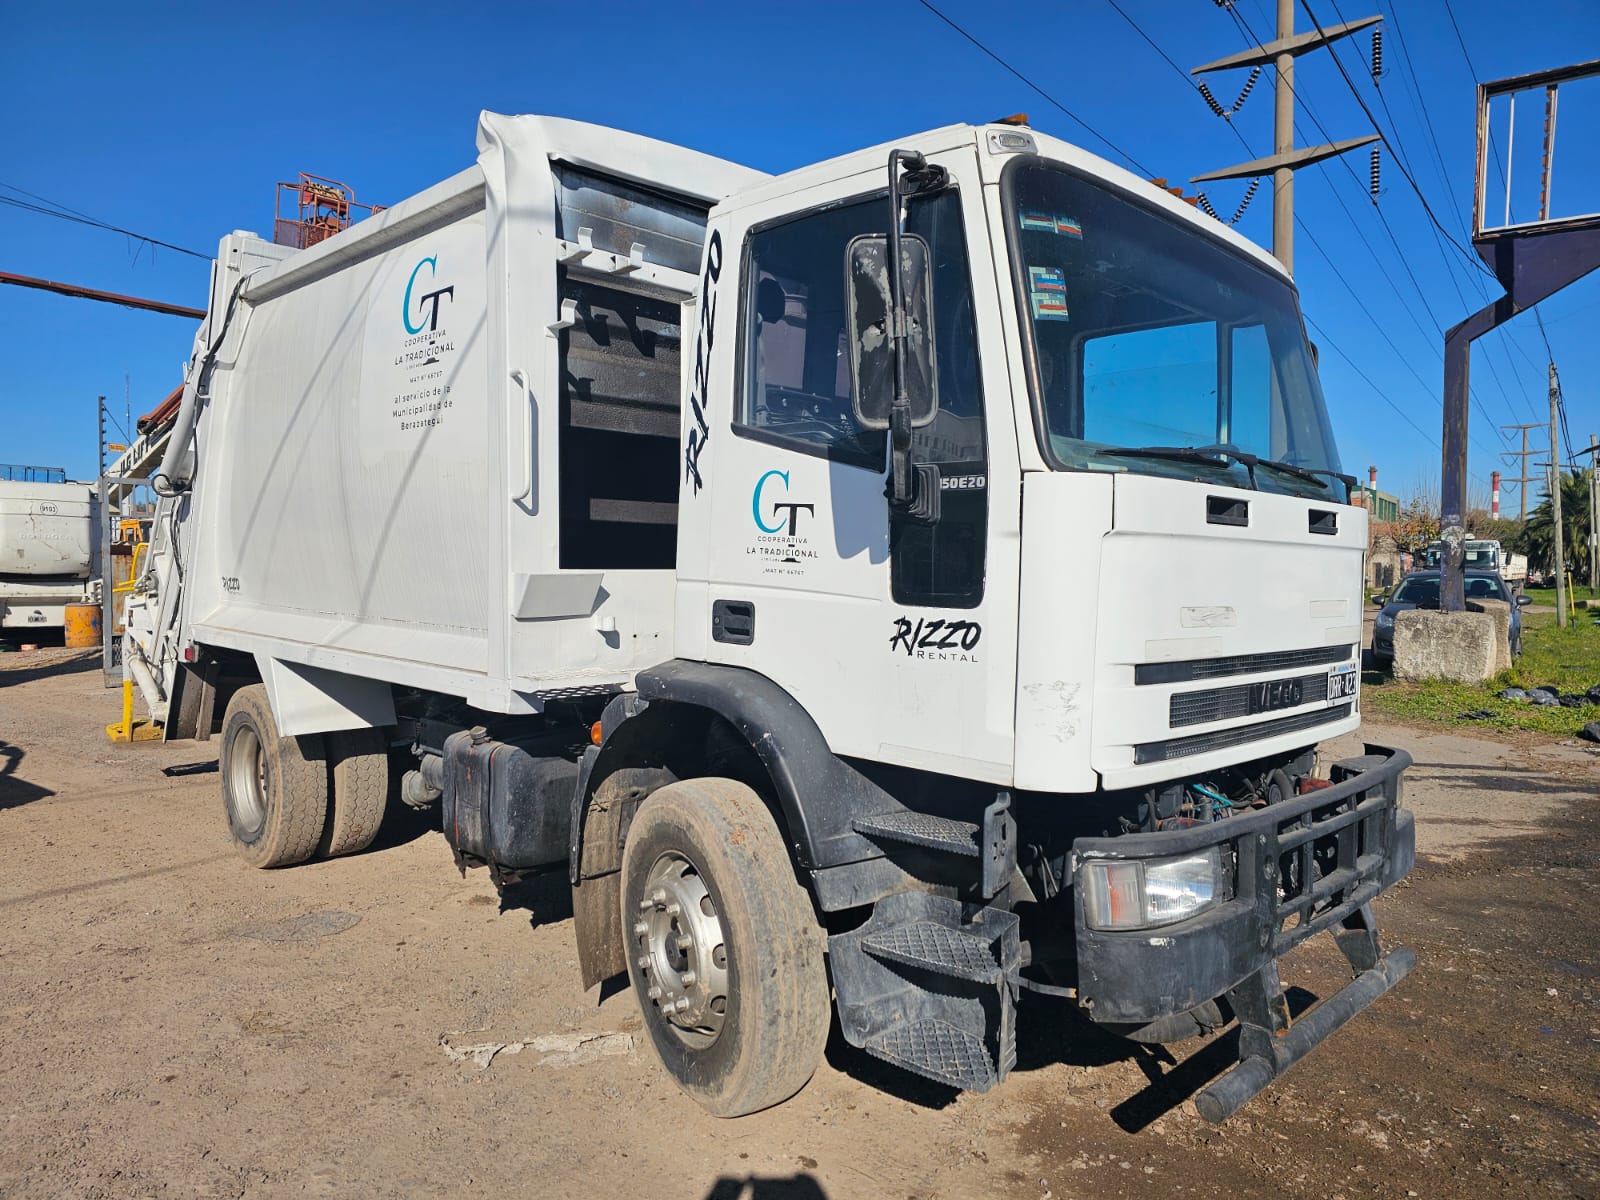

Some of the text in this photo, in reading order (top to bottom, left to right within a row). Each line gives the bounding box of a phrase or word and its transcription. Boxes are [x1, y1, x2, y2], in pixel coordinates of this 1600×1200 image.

[404, 329, 447, 347] COOPERATIVA
[395, 342, 455, 365] LA TRADICIONAL
[686, 228, 723, 500] RIZZO
[394, 385, 451, 404] al servicio de la
[392, 400, 453, 417] Municipalidad de
[757, 535, 808, 544] COOPERATIVA
[746, 546, 818, 558] LA TRADICIONAL
[889, 615, 982, 657] RIZZO
[917, 650, 978, 663] RENTAL
